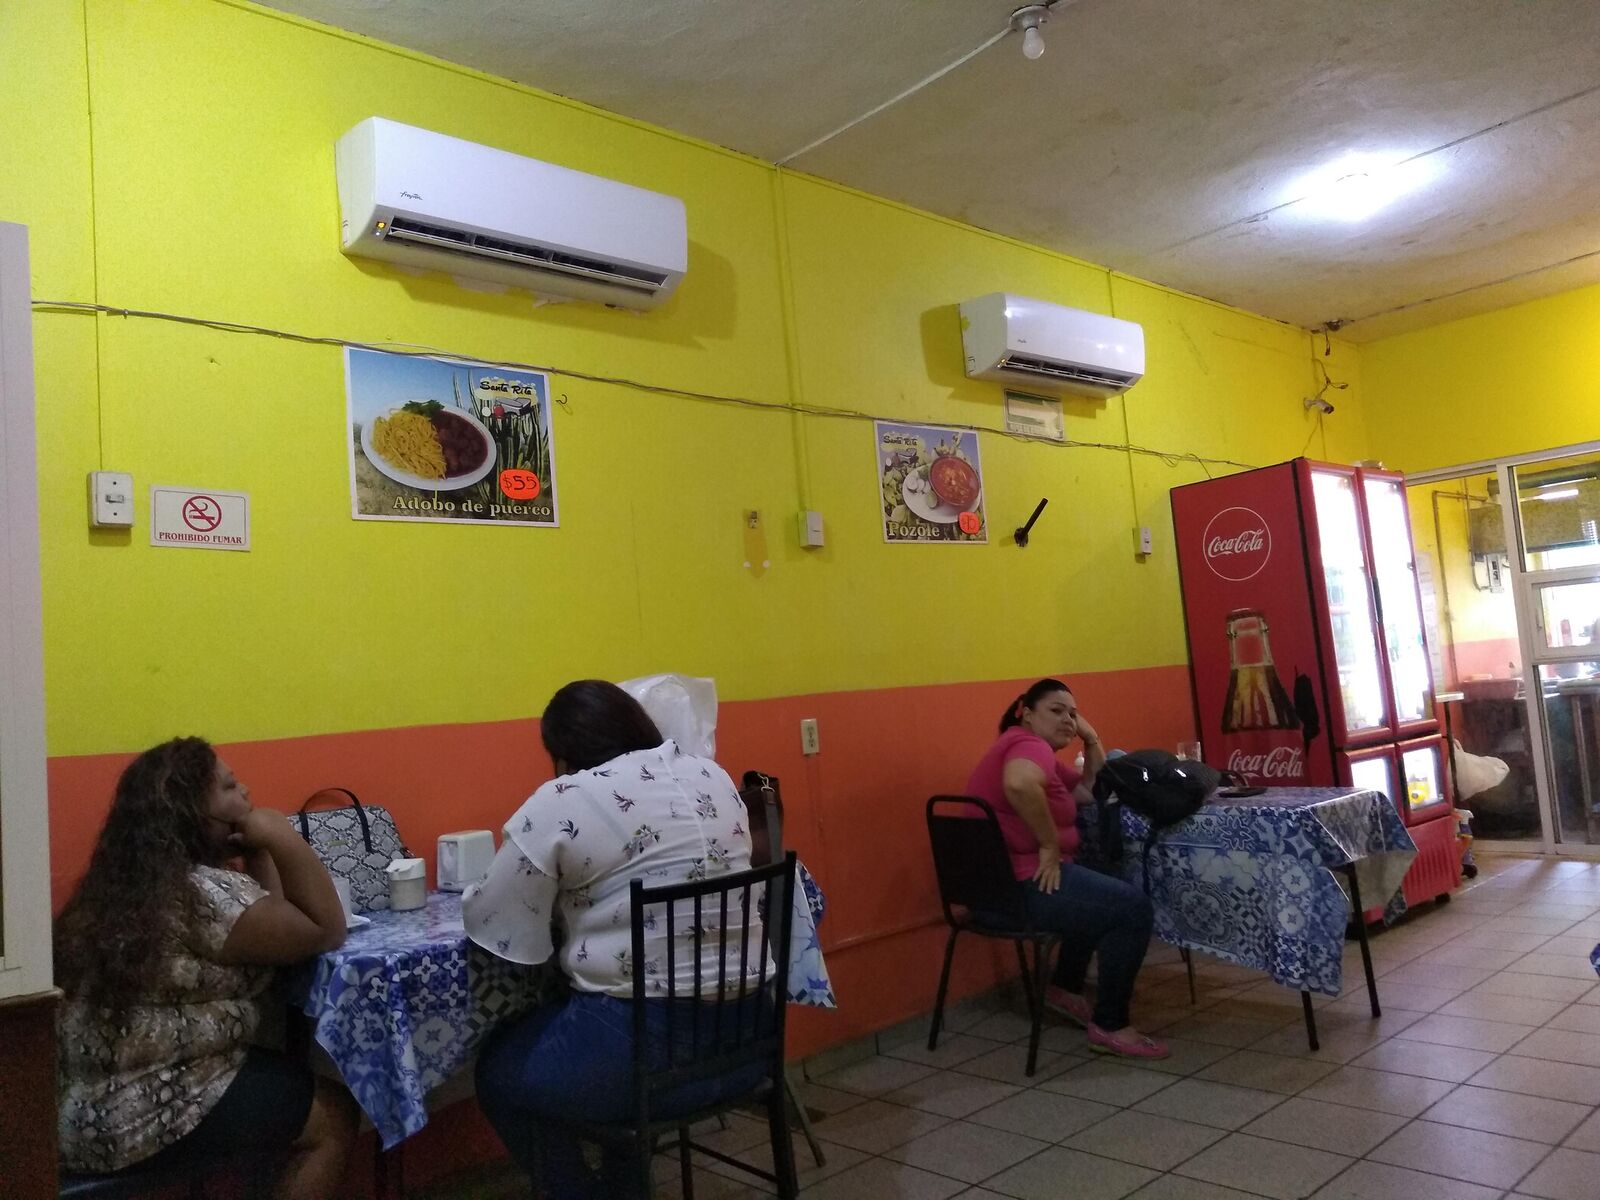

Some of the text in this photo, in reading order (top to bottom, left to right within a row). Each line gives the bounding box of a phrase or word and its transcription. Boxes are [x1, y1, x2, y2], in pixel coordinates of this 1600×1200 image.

[480, 381, 533, 395] Santa Rita
[502, 475, 538, 491] $55
[393, 496, 551, 517] Adobo de puerco
[888, 521, 941, 537] Pozole
[159, 531, 242, 544] PROHIBIDO FUMAR
[1208, 529, 1264, 557] Coca-Cola
